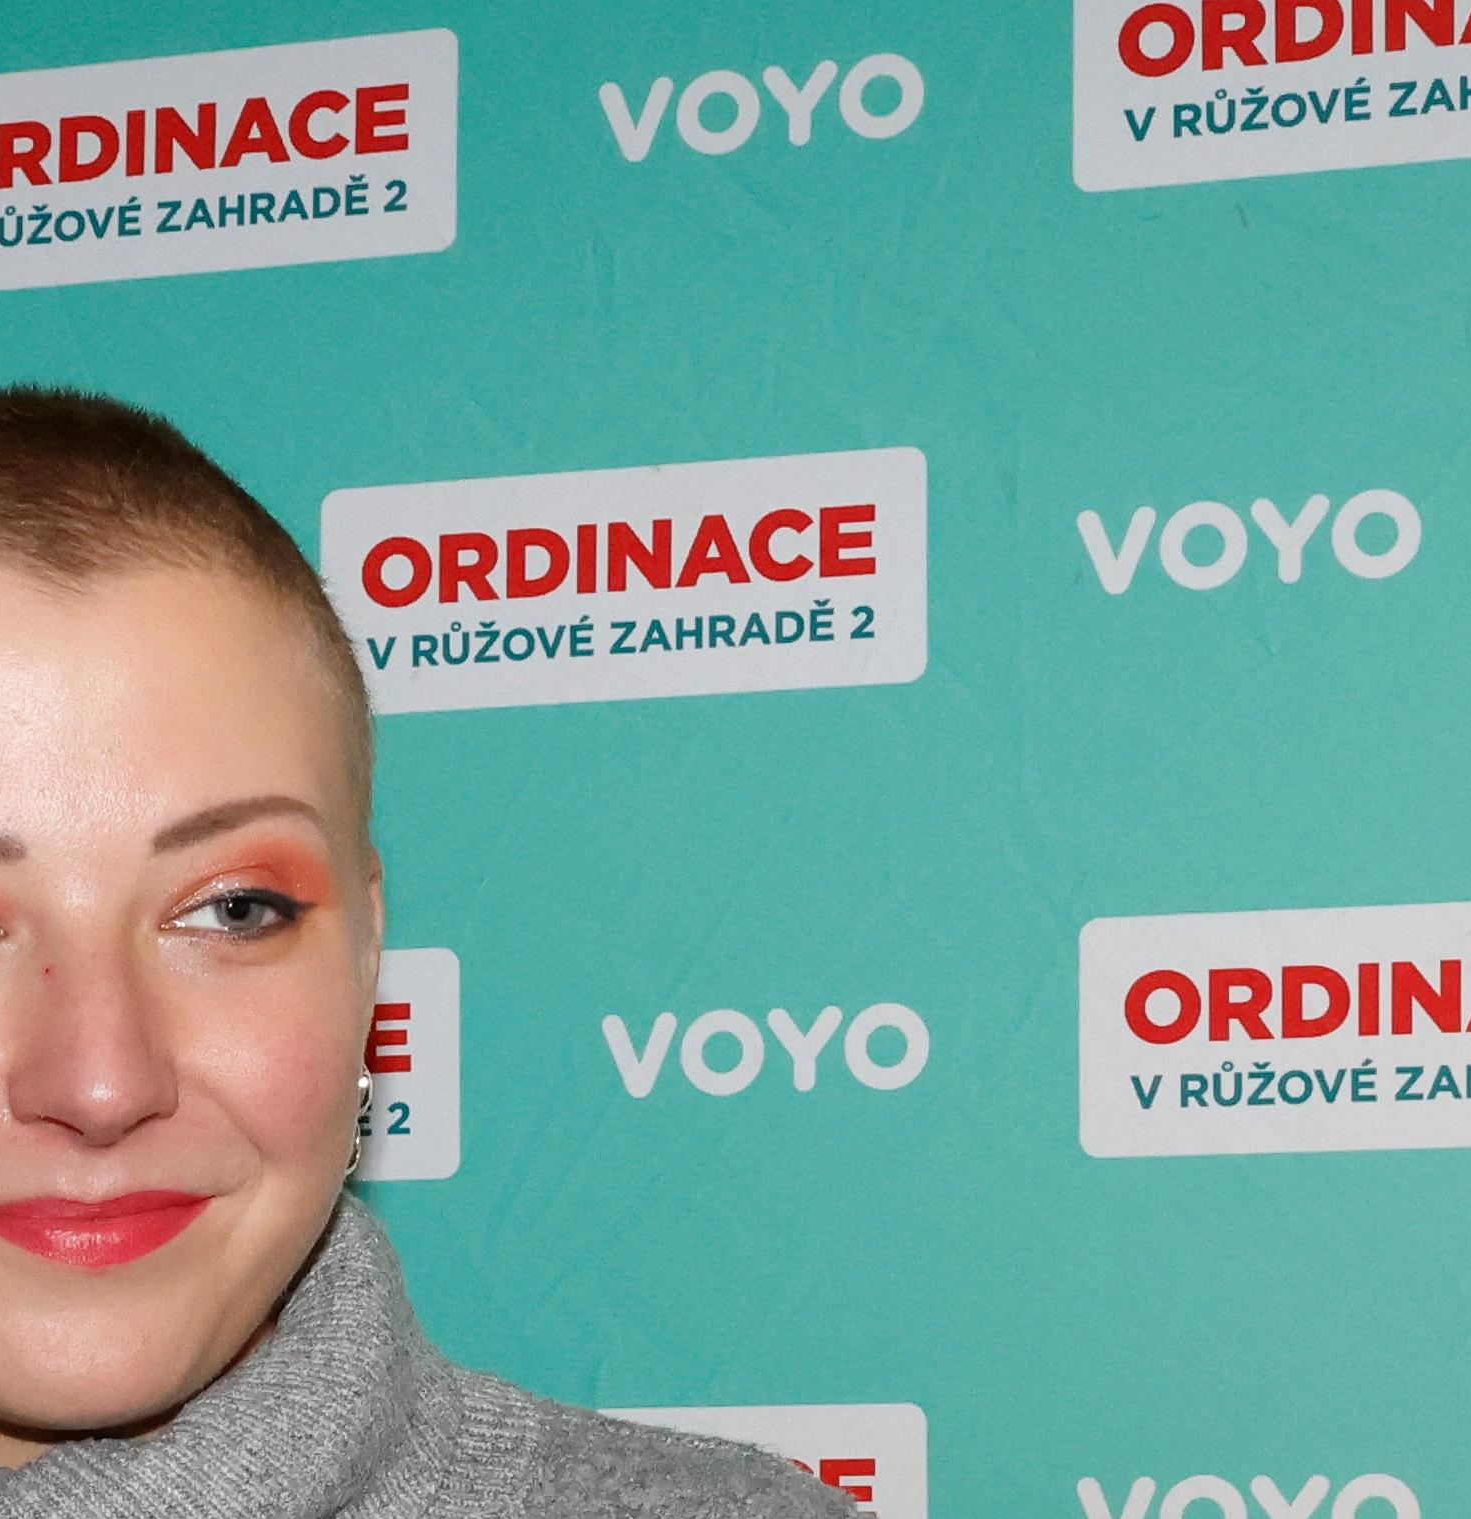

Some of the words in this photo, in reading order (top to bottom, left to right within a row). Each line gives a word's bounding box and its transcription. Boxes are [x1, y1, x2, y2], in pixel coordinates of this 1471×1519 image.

[599, 53, 925, 162] VOYO
[155, 173, 370, 235] ZAHRADĚ
[383, 178, 408, 213] 2
[362, 505, 875, 607] ORDINACE
[1077, 488, 1423, 595] VOYO
[366, 635, 397, 671] V
[411, 614, 595, 668] RŮŽOVÉ
[609, 597, 835, 656] ZAHRADĚ
[849, 603, 876, 640] 2
[602, 1002, 931, 1098] VOYO
[1130, 1073, 1163, 1110] V
[1180, 1057, 1378, 1109] RŮŽOVÉ
